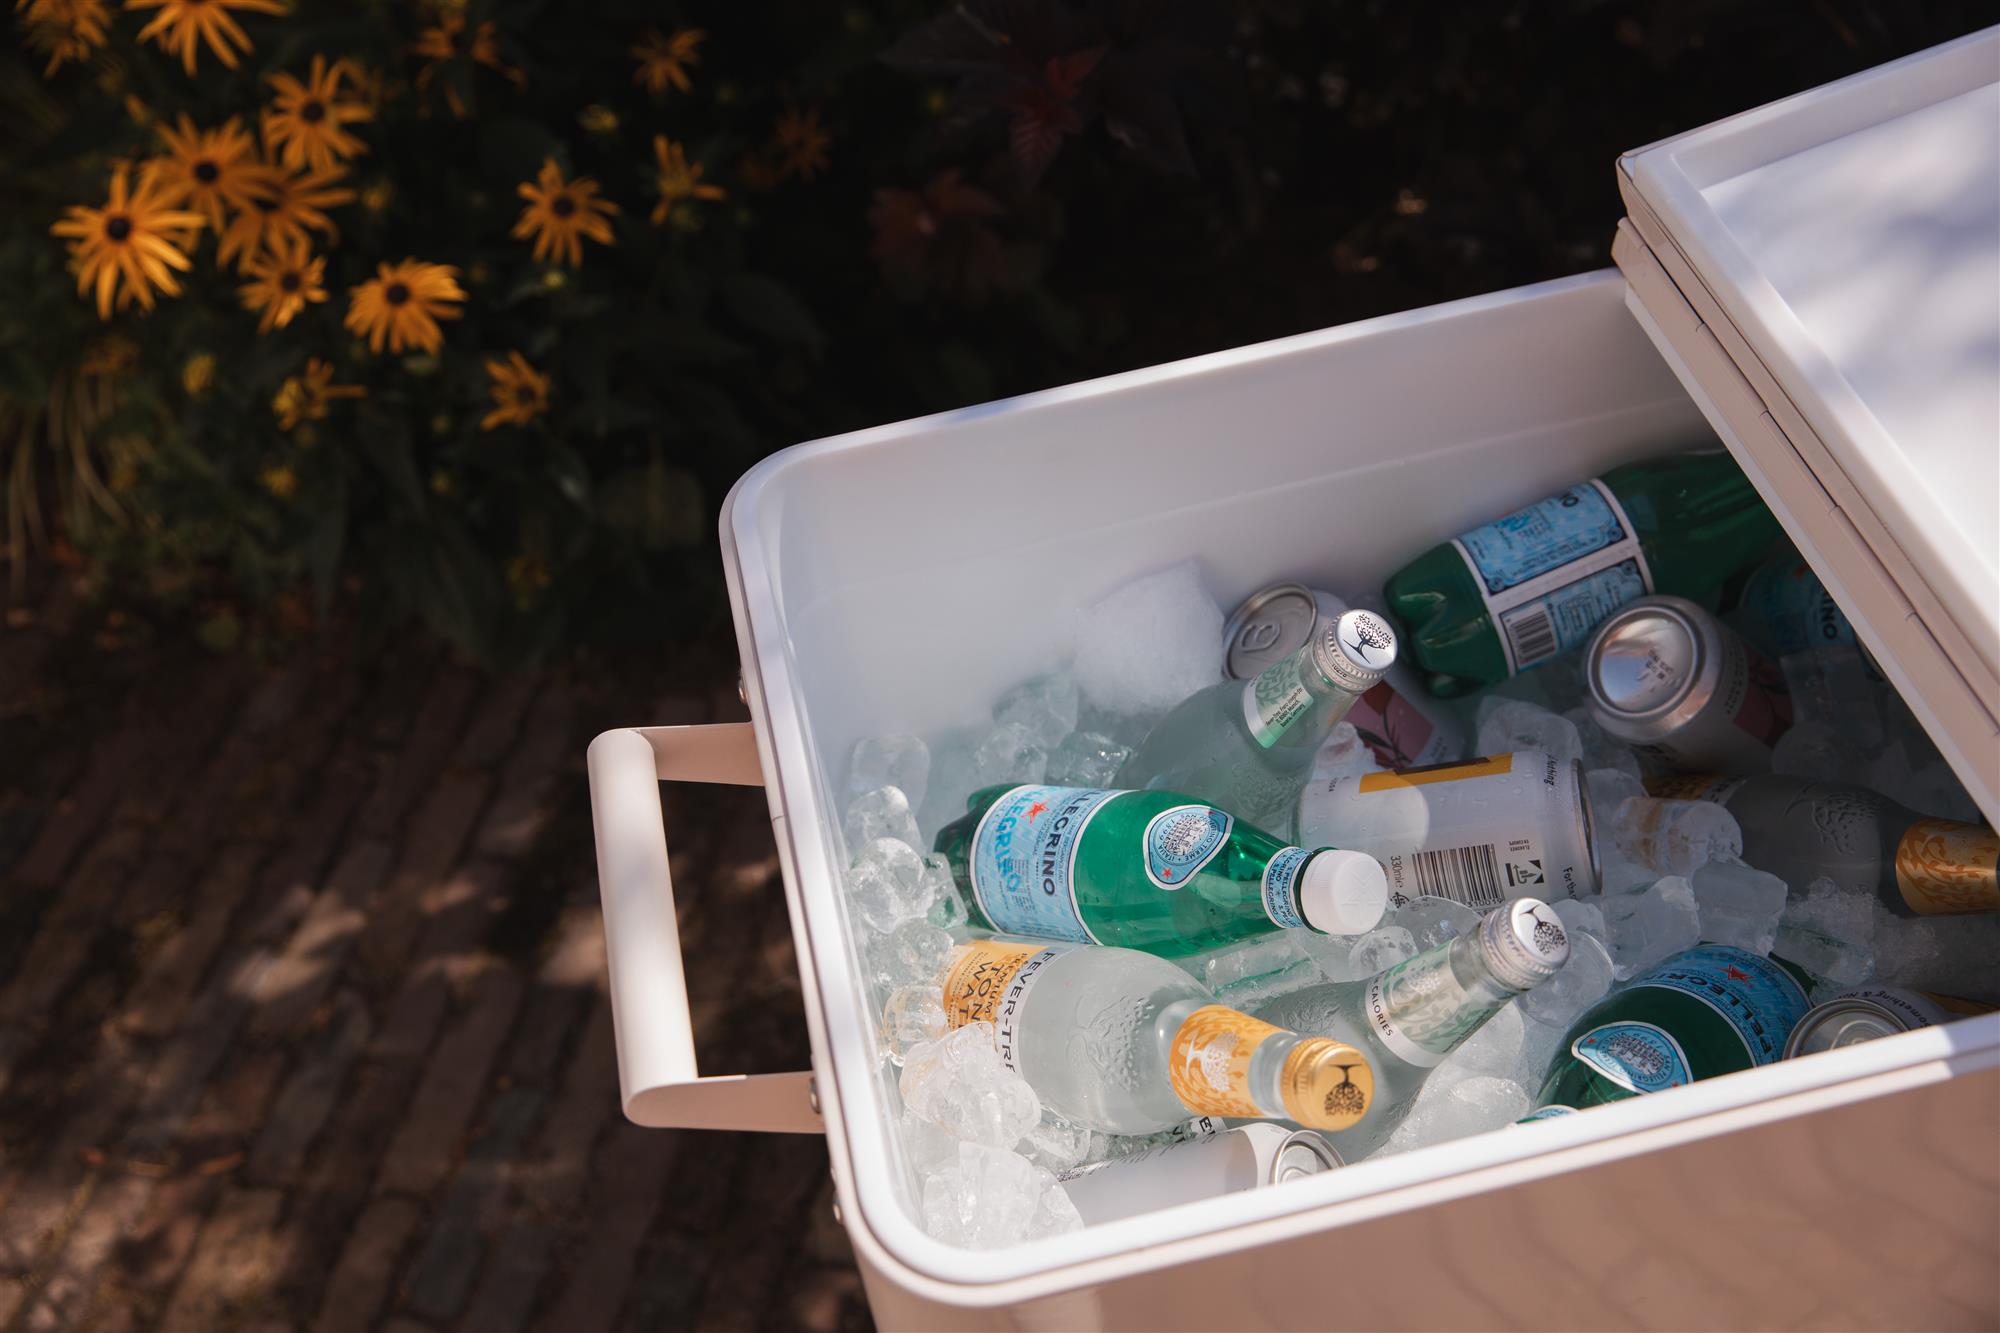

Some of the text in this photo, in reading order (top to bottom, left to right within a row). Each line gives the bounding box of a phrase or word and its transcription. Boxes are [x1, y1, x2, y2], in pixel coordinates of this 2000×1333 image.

[1184, 844, 1207, 861] TERME
[970, 964, 1005, 1021] TON
[1371, 985, 1394, 1037] CALORIES
